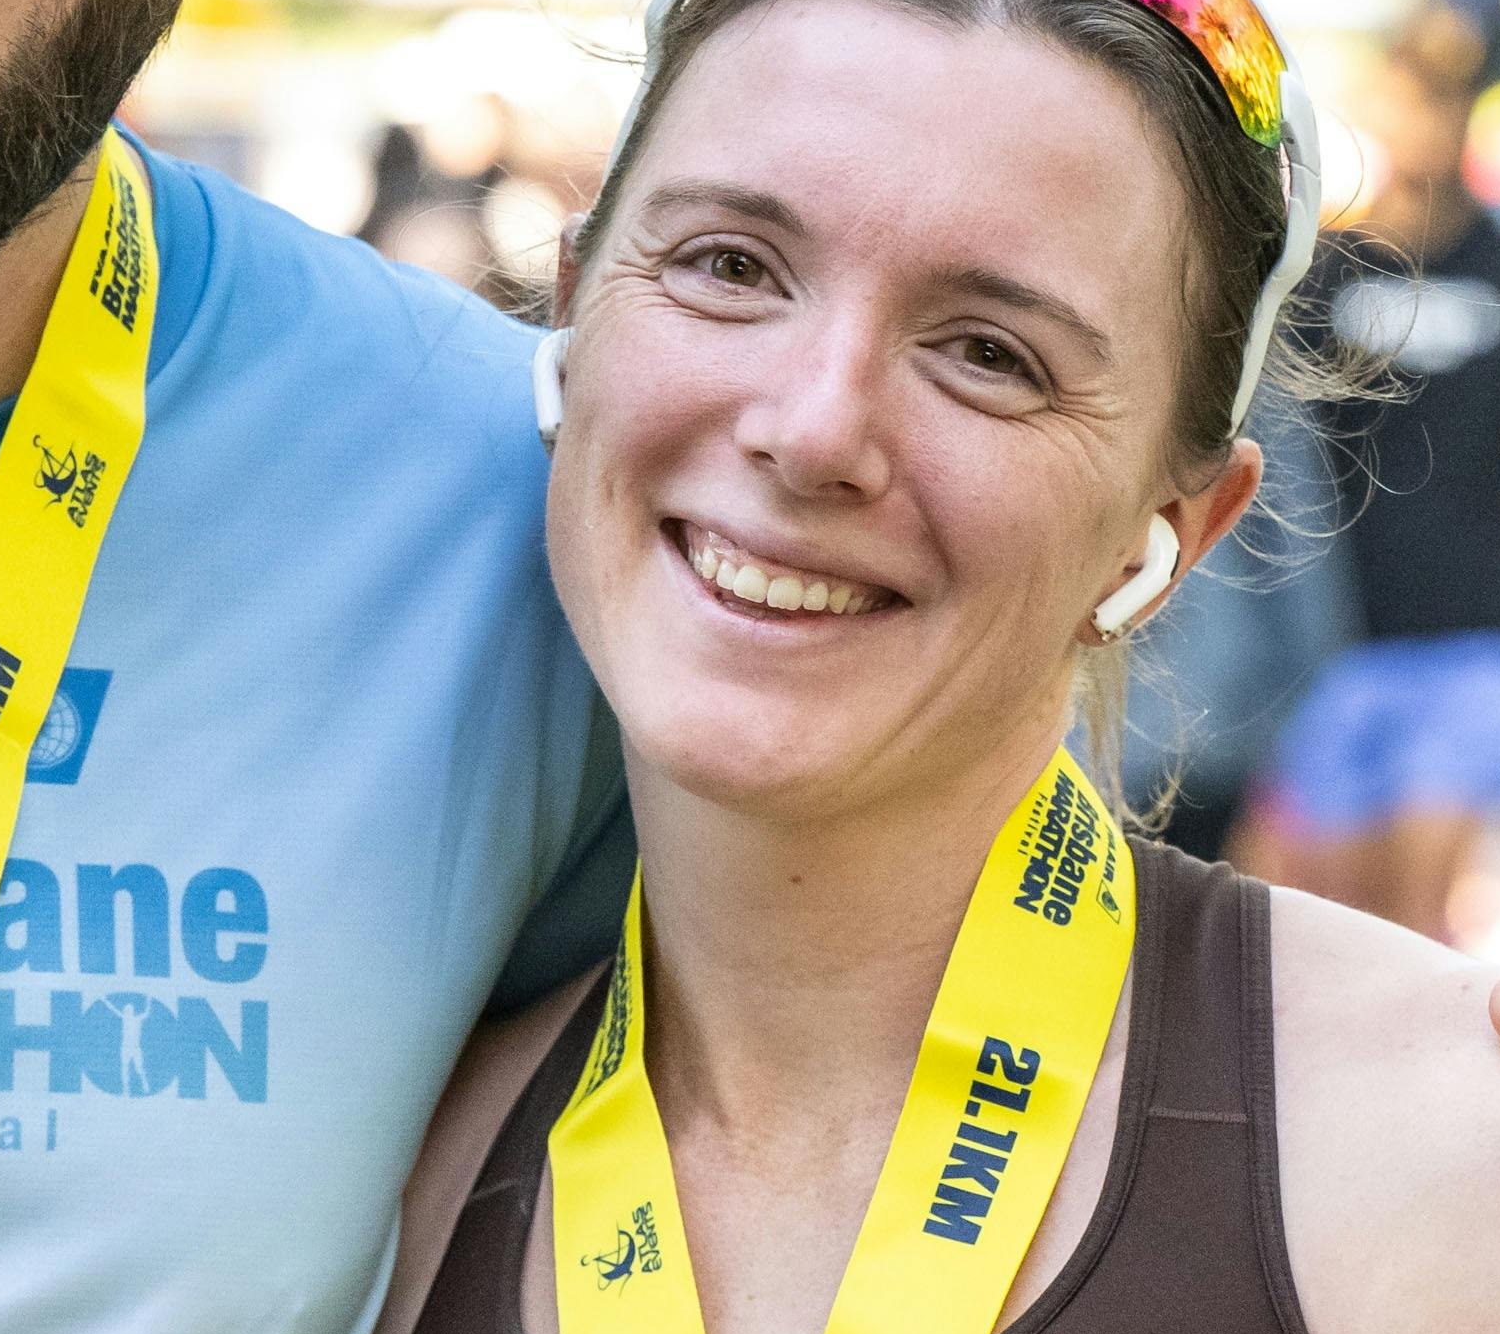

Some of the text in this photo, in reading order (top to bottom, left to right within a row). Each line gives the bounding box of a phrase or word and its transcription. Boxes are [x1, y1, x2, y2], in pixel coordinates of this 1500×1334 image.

[1013, 768, 1075, 914] MARATHON
[1042, 788, 1101, 926] Brisbane
[923, 1036, 1041, 1245] 21.1KM
